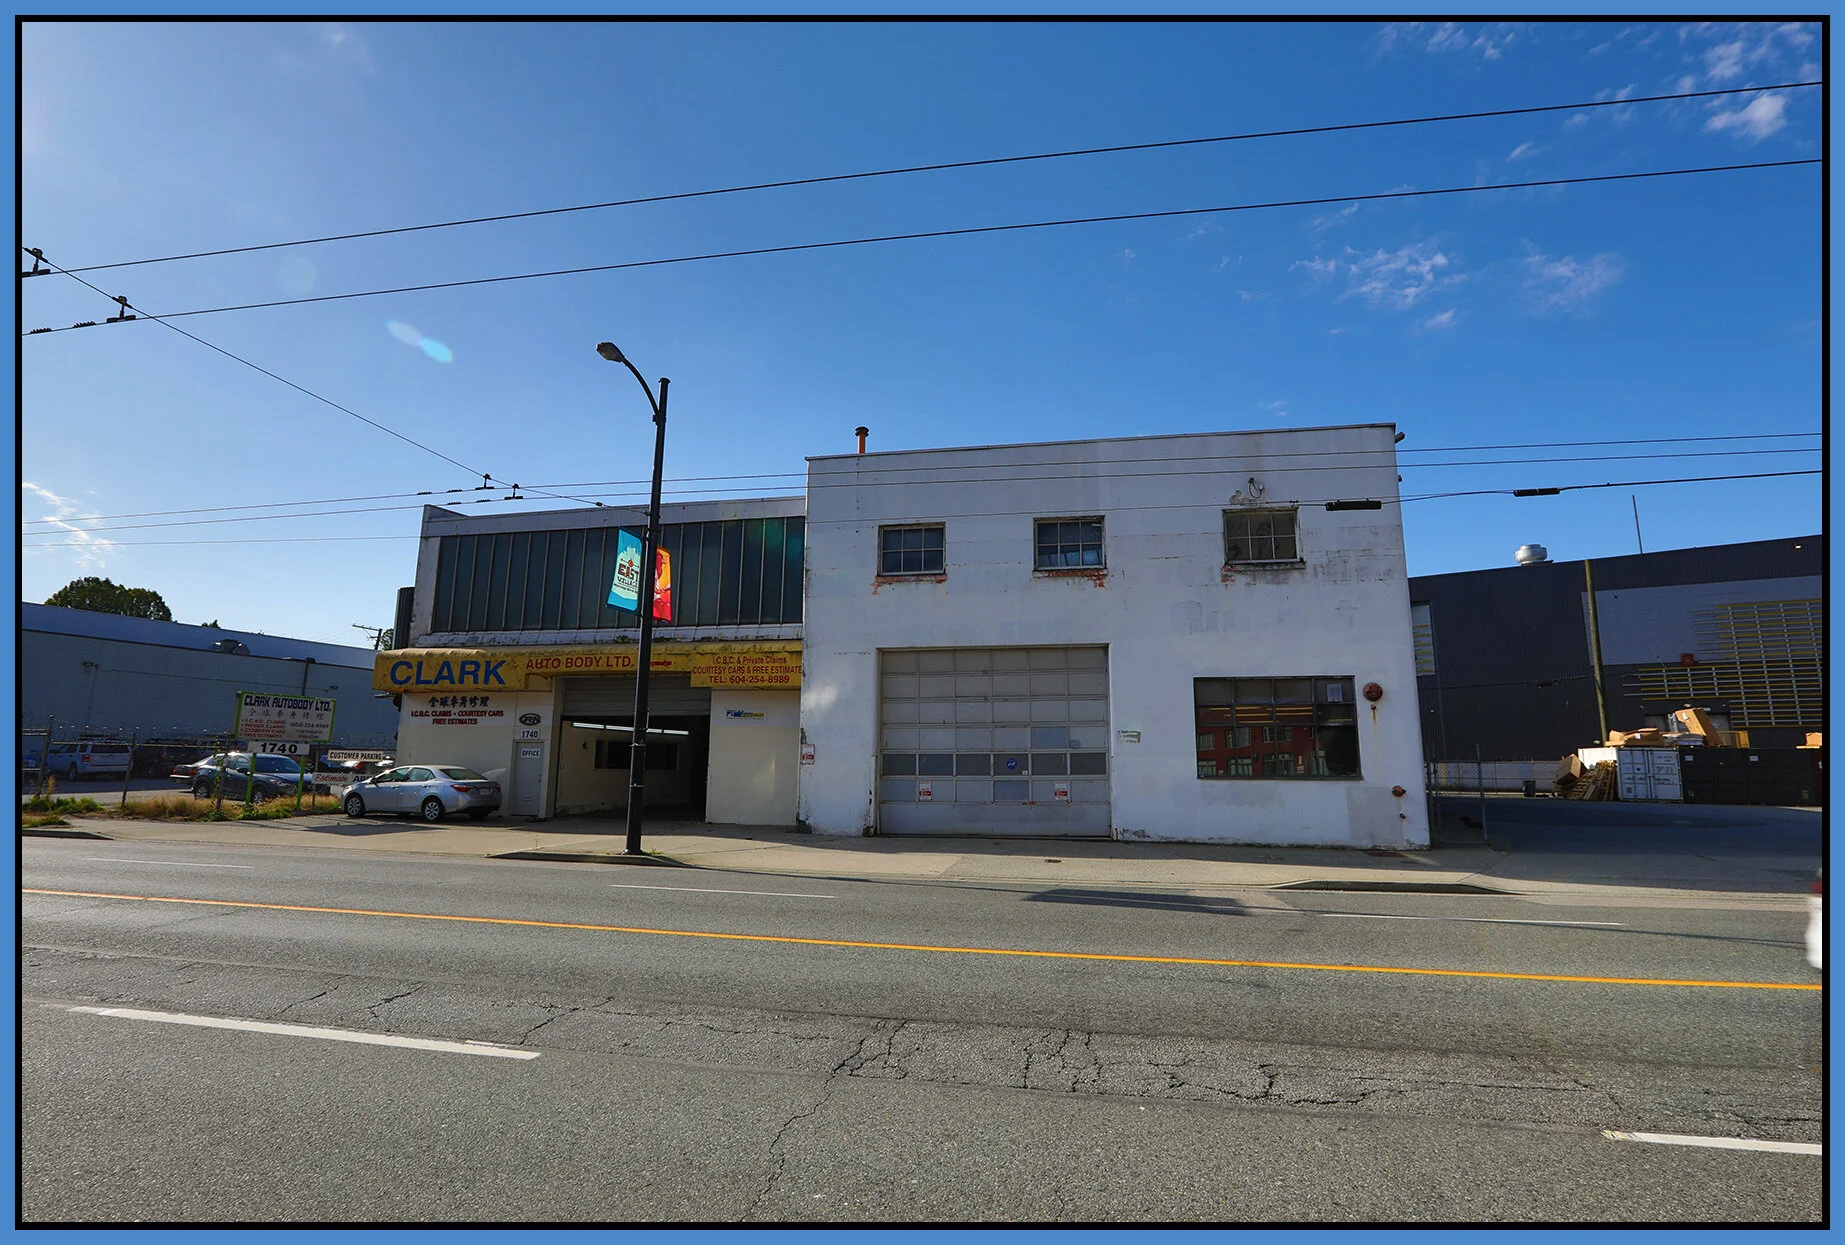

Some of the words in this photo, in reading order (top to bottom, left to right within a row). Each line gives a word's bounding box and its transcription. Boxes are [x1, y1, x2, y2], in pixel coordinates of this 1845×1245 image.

[618, 563, 639, 582] EAST
[526, 658, 561, 670] AUTO
[564, 656, 602, 668] BODY
[606, 656, 634, 668] LTD.
[743, 656, 764, 664] Private
[766, 656, 787, 664] Claims
[390, 660, 508, 685] CLARK
[692, 666, 726, 674] COURTESY
[728, 666, 745, 674] CARS
[709, 676, 727, 684] TEL:
[730, 675, 790, 684] 604-254-8989
[244, 695, 271, 707] CLARK
[272, 698, 313, 710] AUTOBODY
[315, 700, 331, 712] LTD.
[260, 742, 298, 753] 1740
[315, 774, 348, 782] Estimate
